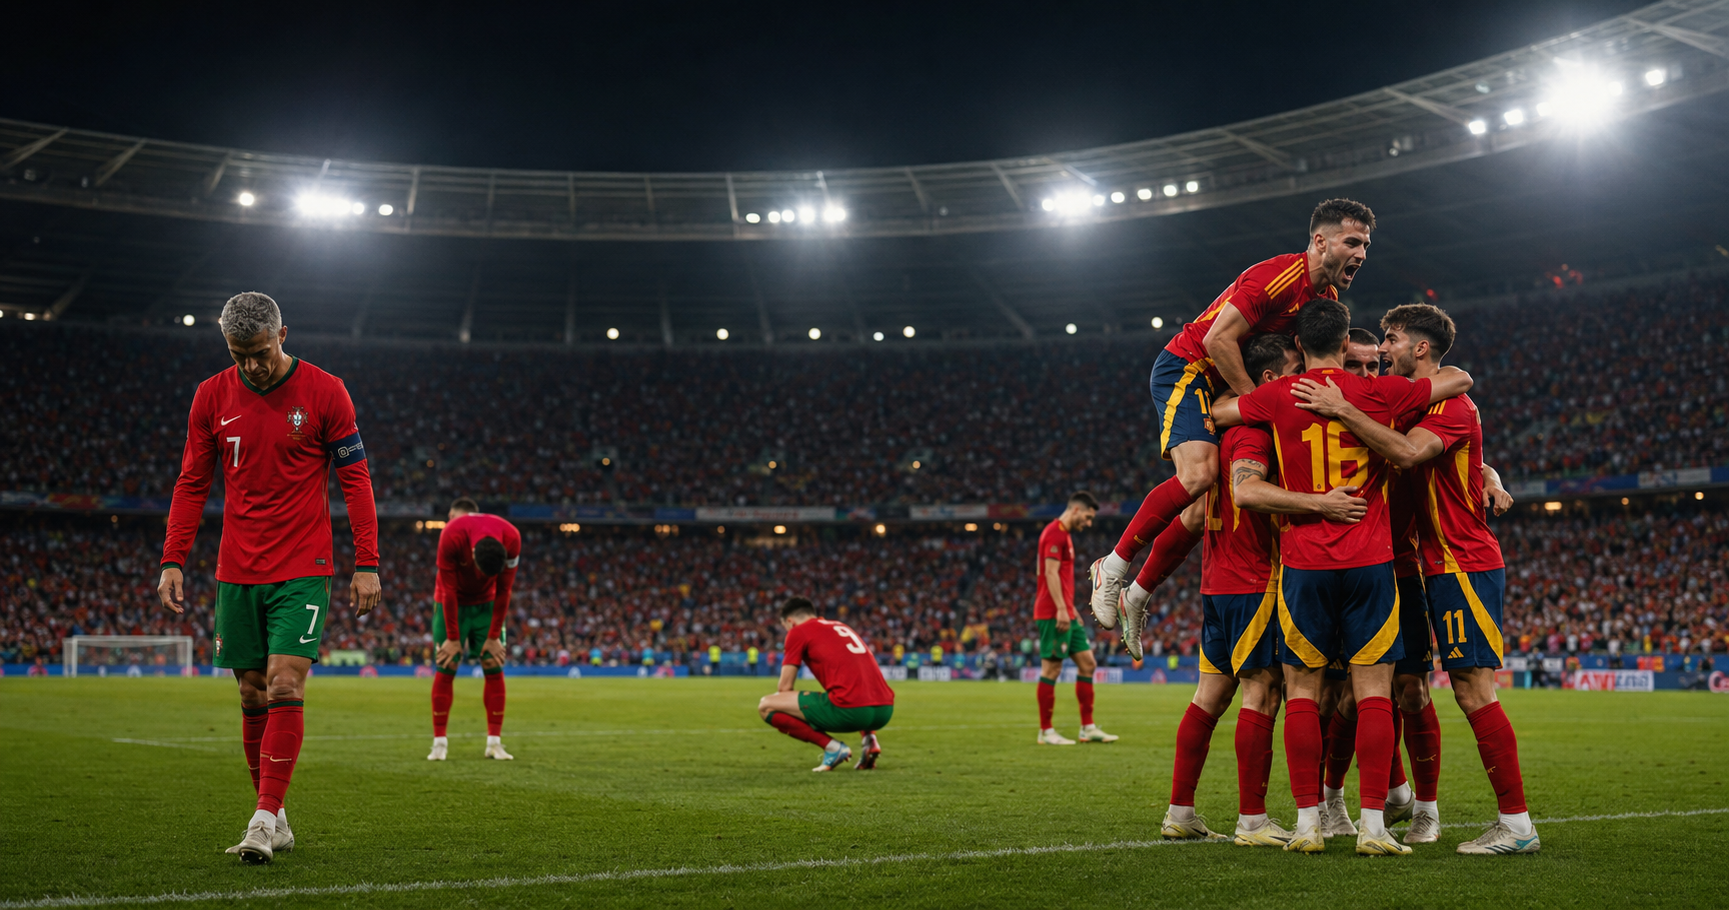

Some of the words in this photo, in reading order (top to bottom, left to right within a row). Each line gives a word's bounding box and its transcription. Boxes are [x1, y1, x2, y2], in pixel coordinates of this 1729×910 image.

[226, 436, 241, 468] 7
[1301, 420, 1370, 492] 16
[305, 603, 320, 635] 7
[1442, 609, 1468, 645] 11
[833, 625, 867, 654] 9
